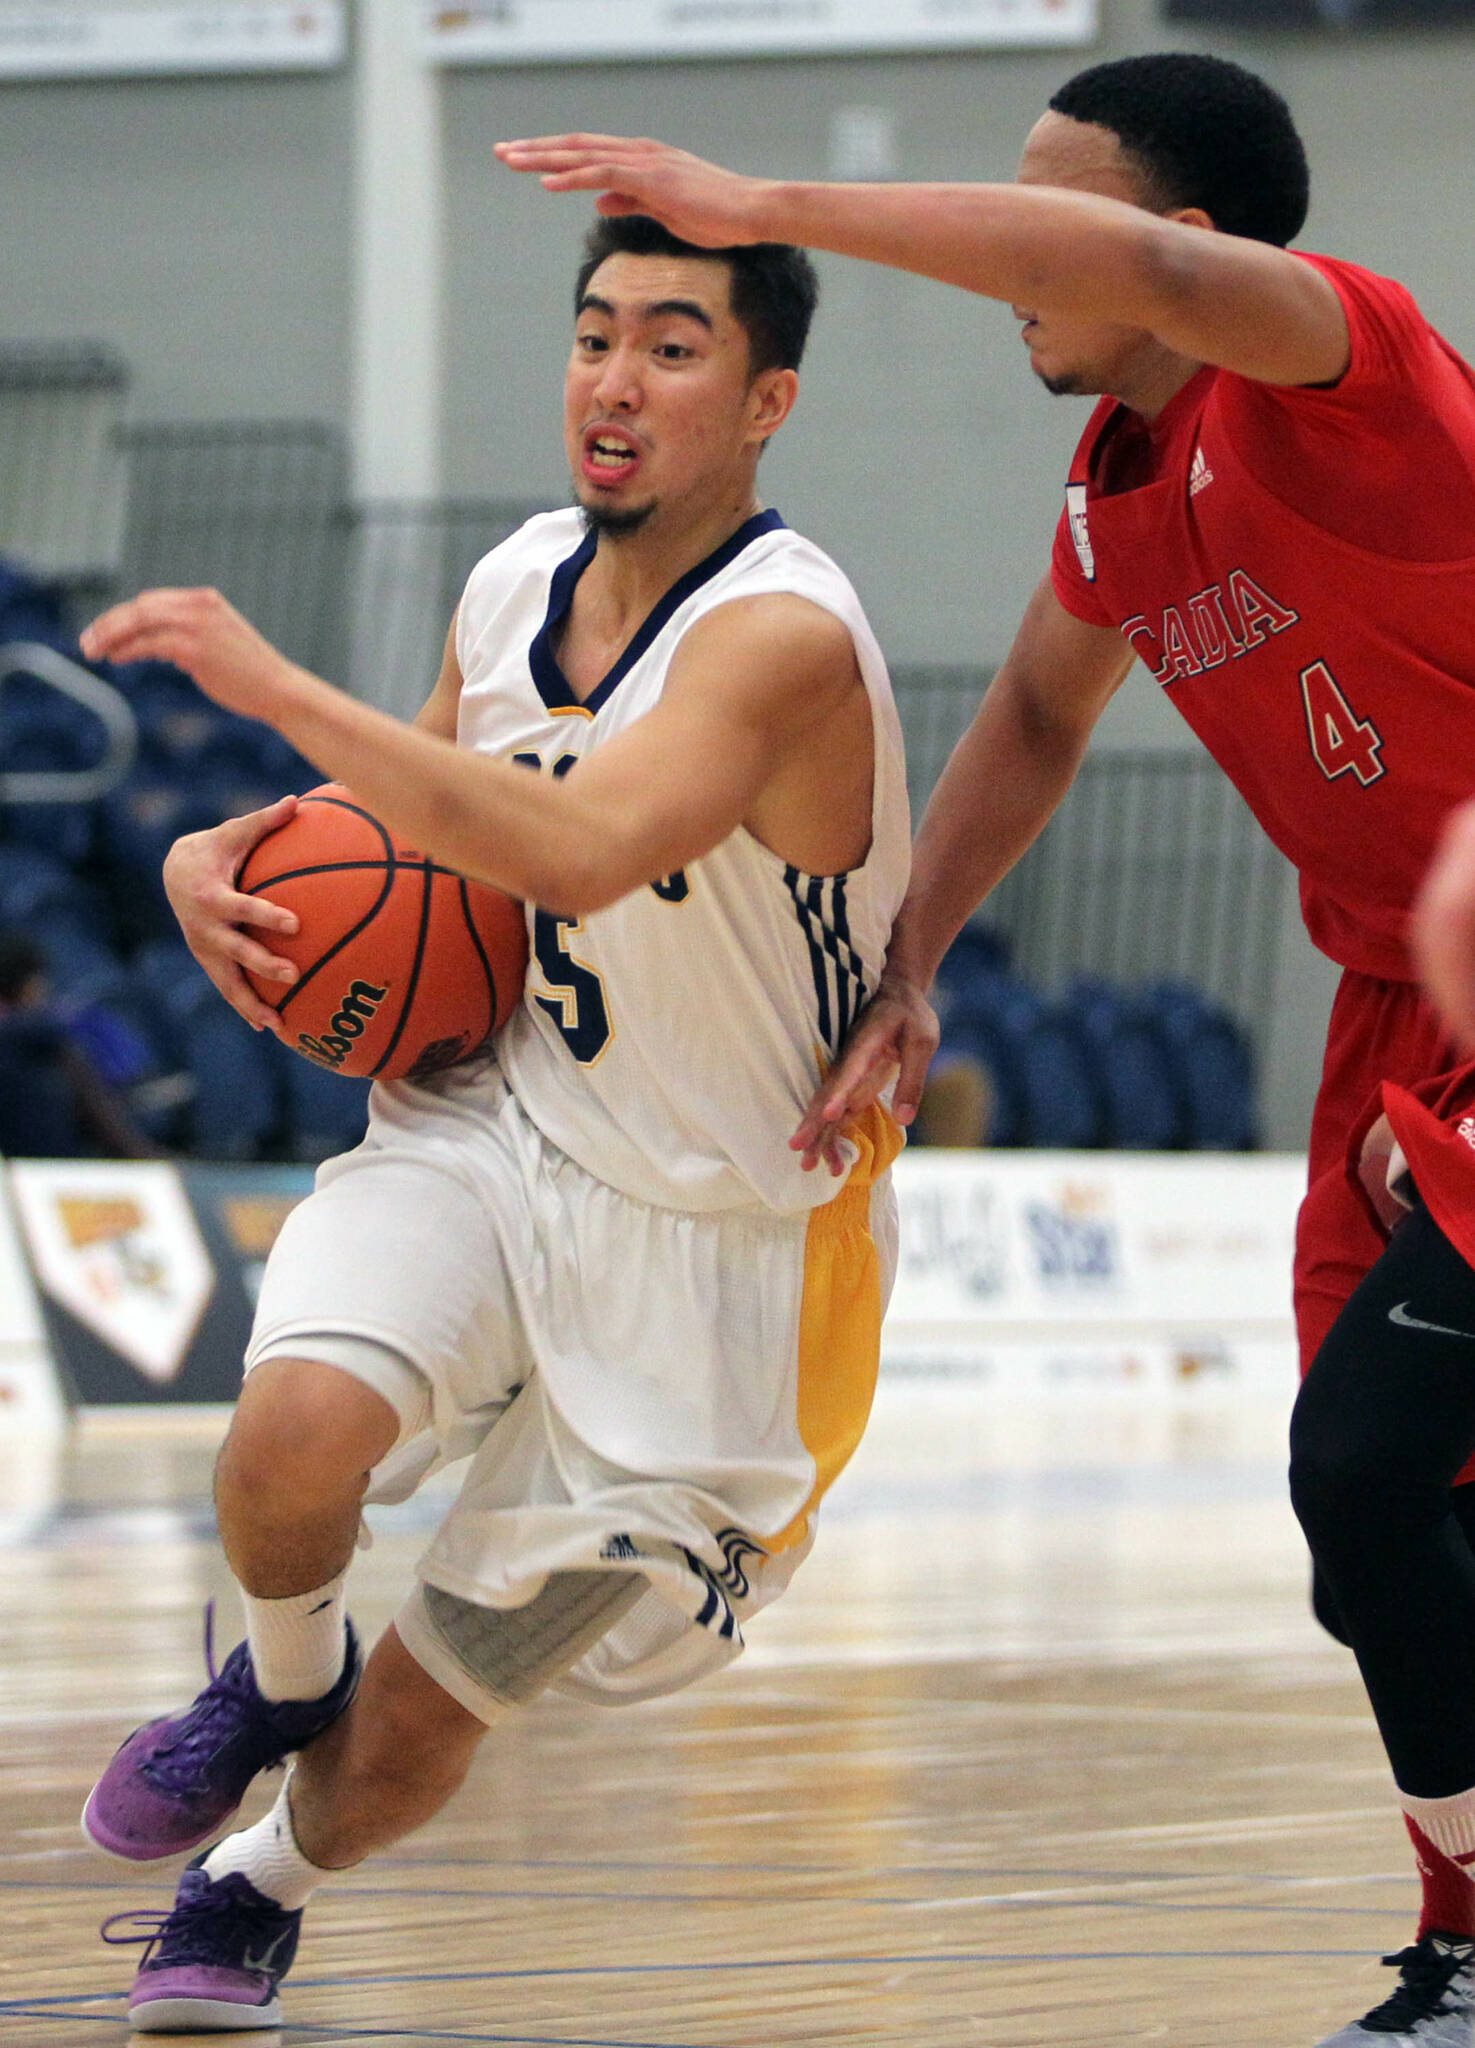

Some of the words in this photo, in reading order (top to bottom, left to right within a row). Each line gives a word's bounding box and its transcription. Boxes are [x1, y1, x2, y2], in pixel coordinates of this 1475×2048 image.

[1121, 568, 1300, 687] CADIA
[1299, 658, 1387, 790] 4
[297, 979, 389, 1066] lson
[530, 902, 616, 1069] 5
